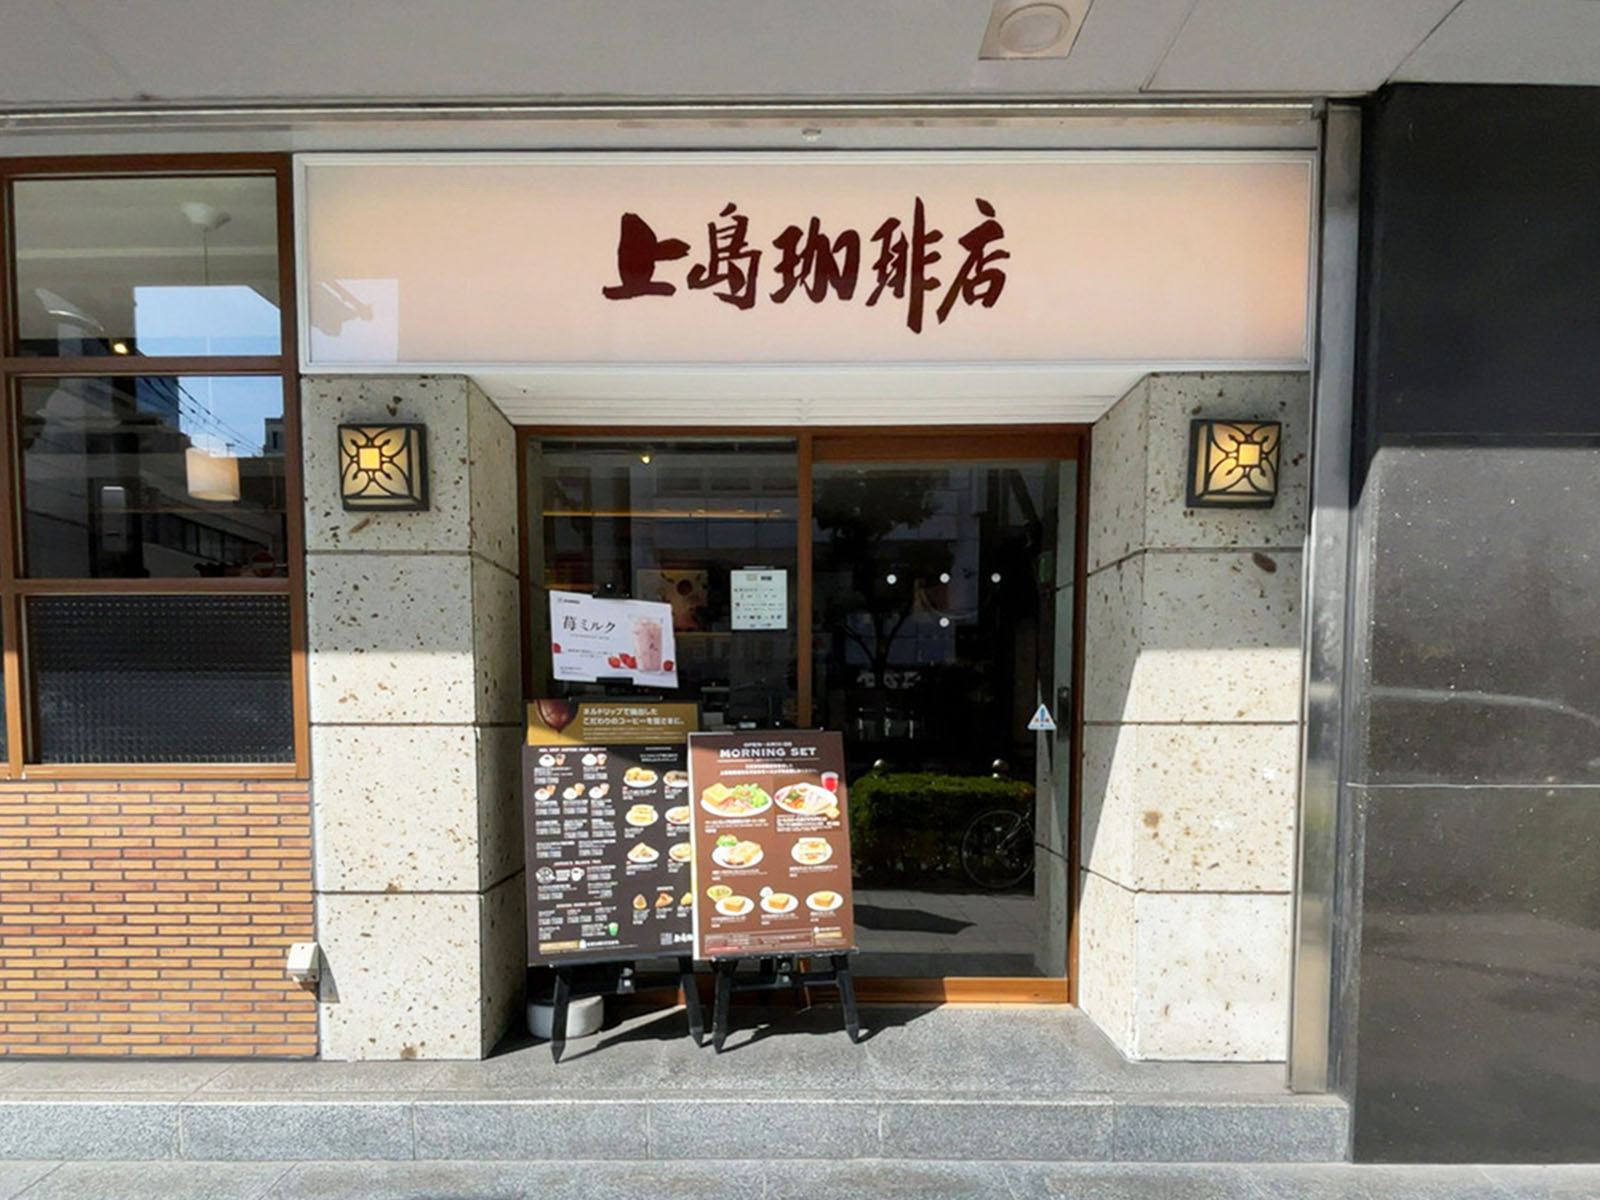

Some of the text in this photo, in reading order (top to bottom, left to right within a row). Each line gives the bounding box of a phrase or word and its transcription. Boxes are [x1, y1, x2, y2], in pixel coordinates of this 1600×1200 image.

[602, 196, 1011, 334] 上島珈琲店
[563, 615, 616, 633] 苺ミルク
[719, 747, 817, 758] MORNING SET
